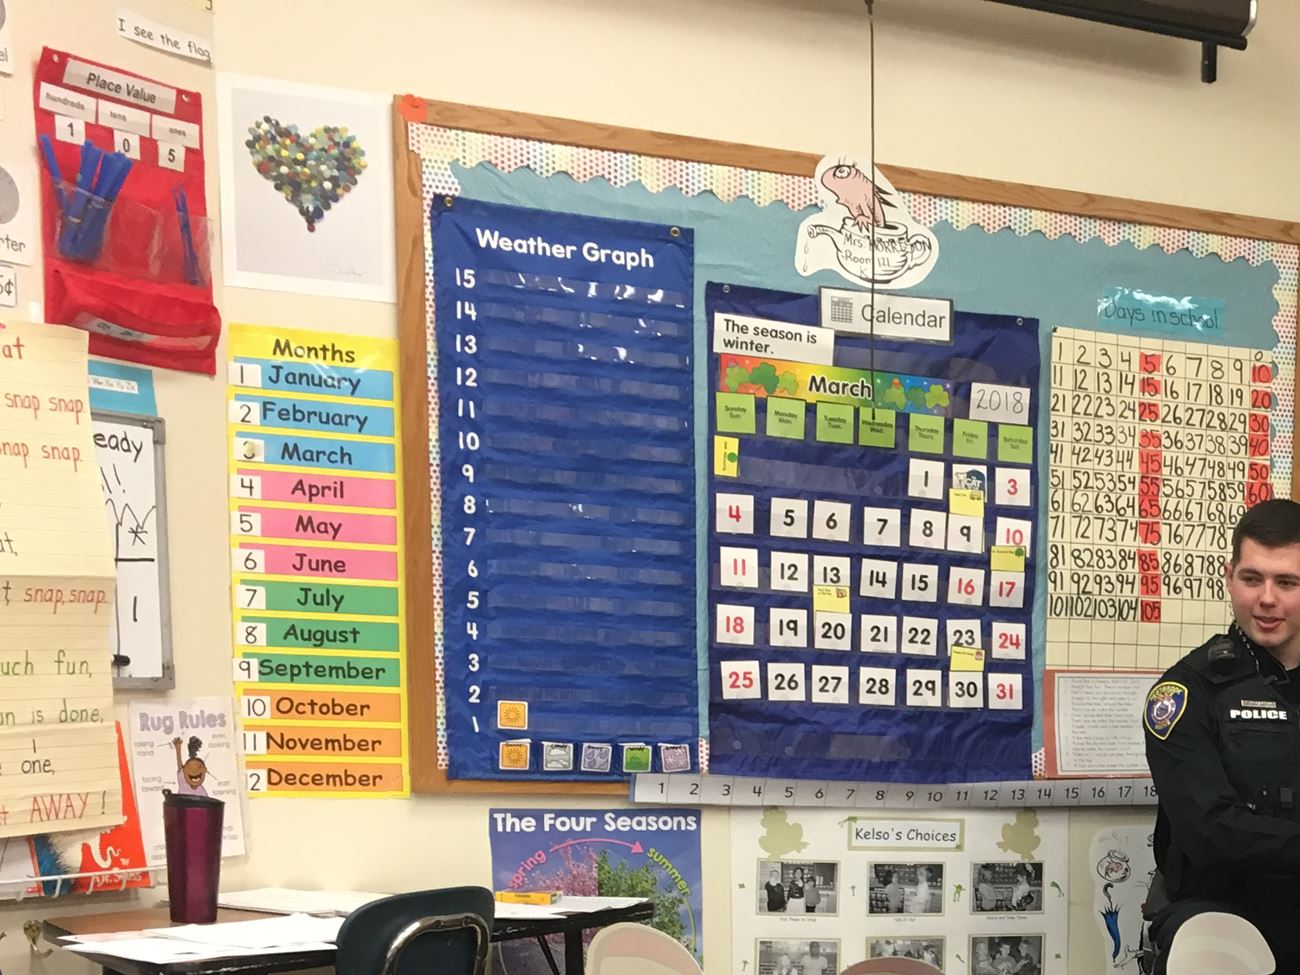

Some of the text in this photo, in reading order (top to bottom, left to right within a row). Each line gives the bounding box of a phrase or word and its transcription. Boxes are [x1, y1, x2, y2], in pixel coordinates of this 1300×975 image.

[118, 18, 211, 62] I see the flag
[87, 72, 157, 104] Place Value
[167, 149, 176, 163] 5
[476, 228, 655, 271] Weather Graph
[456, 268, 476, 289] 15
[456, 300, 477, 321] 14
[861, 304, 946, 329] Calendar
[1104, 303, 1146, 326] Days
[724, 319, 817, 344] The season is
[272, 339, 356, 363] Months
[723, 336, 774, 356] winter.
[268, 365, 361, 396] January
[808, 376, 873, 399] March
[5, 392, 40, 420] snap
[975, 388, 1025, 414] 2018
[262, 401, 368, 433] February
[281, 442, 353, 465] March
[291, 479, 345, 502] April
[295, 515, 342, 540] May
[292, 553, 346, 573] June
[823, 566, 841, 584] 13
[296, 587, 345, 612] July
[283, 624, 360, 647] August
[820, 621, 845, 640] 20
[998, 632, 1021, 650] 24
[54, 649, 92, 678] fun,
[258, 659, 386, 682] September
[817, 676, 842, 693] 27
[32, 697, 104, 724] is done,
[275, 697, 370, 717] October
[1230, 709, 1288, 720] POLICE
[139, 709, 227, 734] Rug Rules
[266, 732, 382, 752] November
[21, 757, 55, 775] one,
[267, 768, 383, 787] December
[927, 786, 1105, 802] 10 16
[30, 792, 89, 823] AWAY
[493, 812, 697, 832] The Four Seasons
[855, 827, 957, 842] Kelso's Choices
[508, 849, 547, 890] spring
[647, 848, 692, 896] summer
